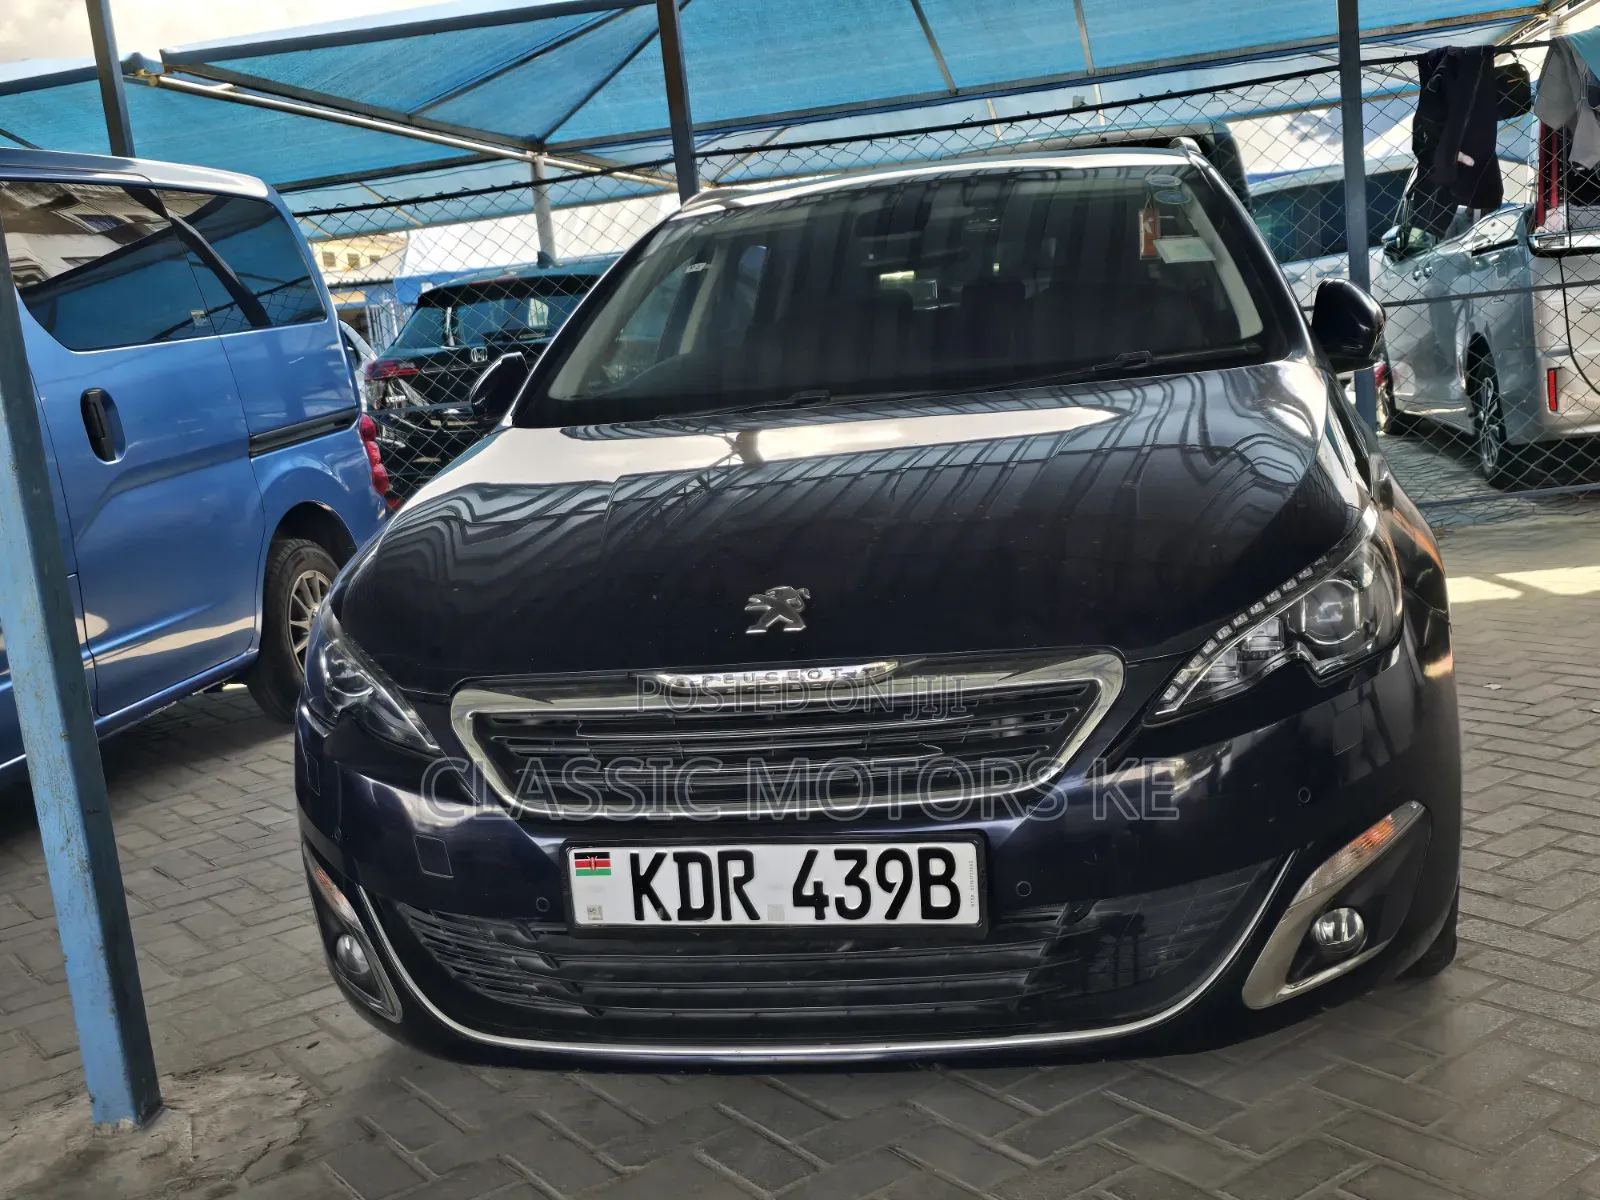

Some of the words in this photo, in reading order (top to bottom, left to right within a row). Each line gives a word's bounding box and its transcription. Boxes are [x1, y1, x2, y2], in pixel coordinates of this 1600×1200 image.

[702, 667, 844, 687] PEUGEOT
[629, 849, 761, 922] KDR
[792, 846, 962, 921] 439B
